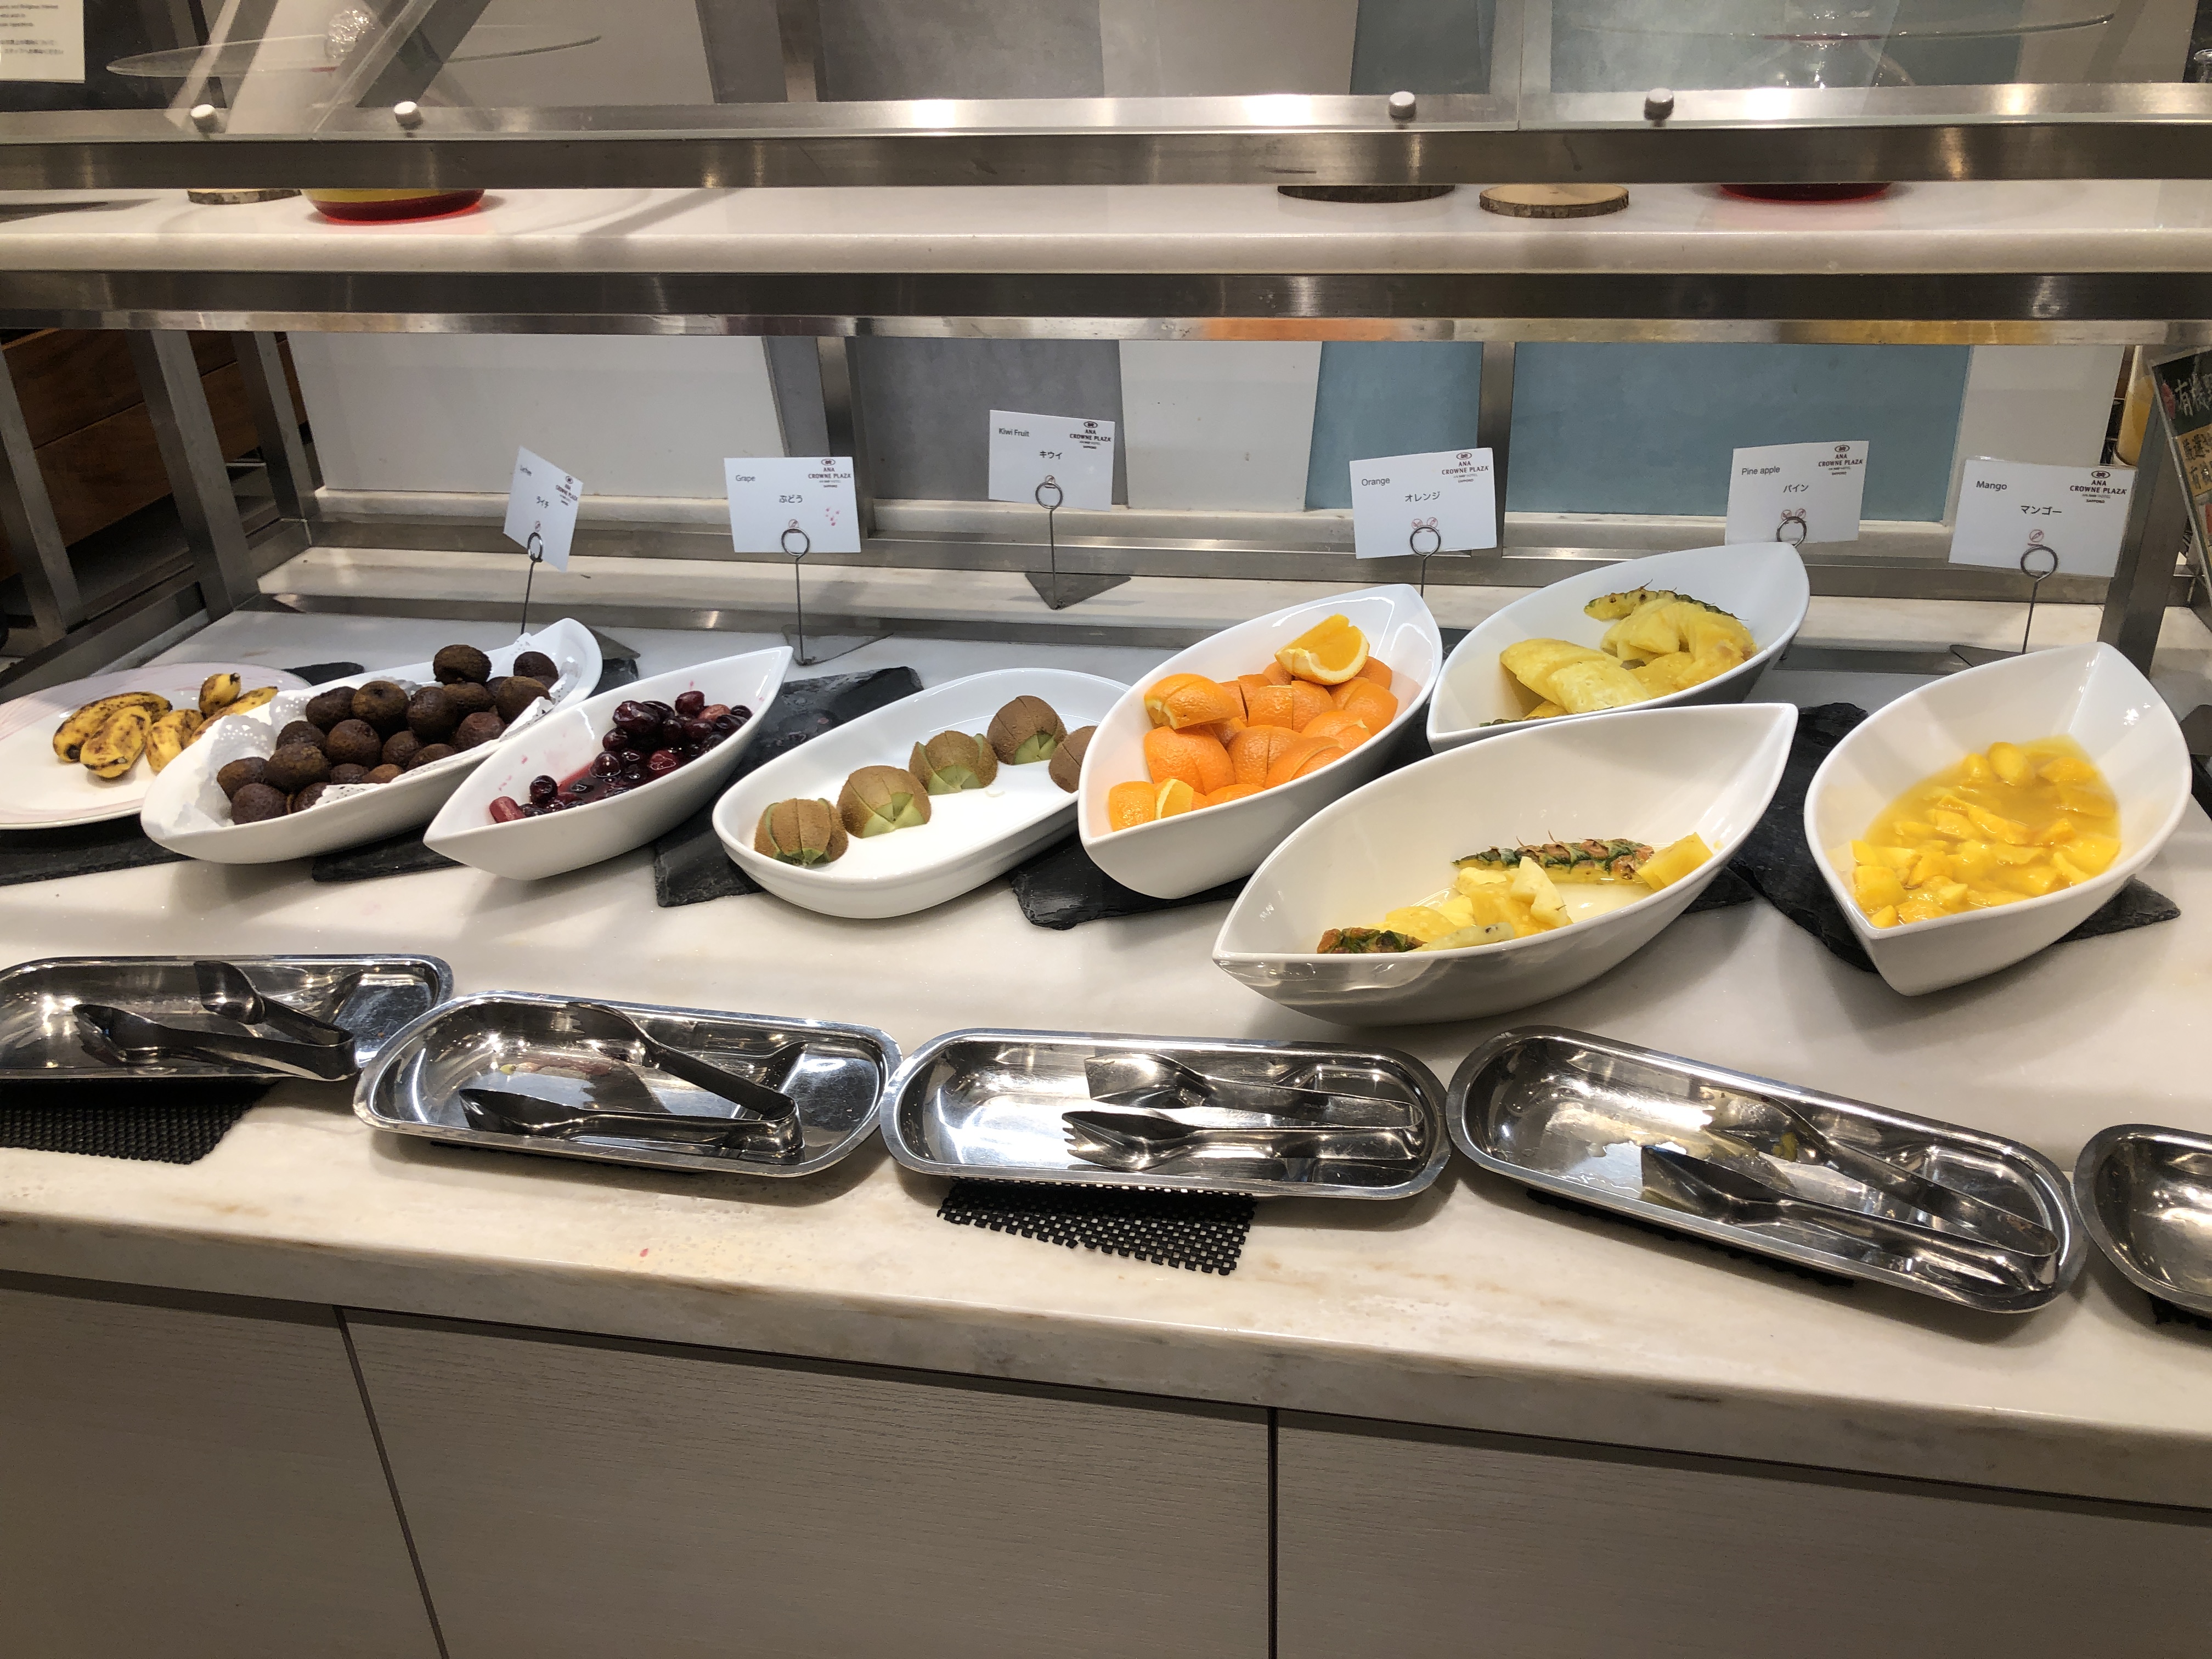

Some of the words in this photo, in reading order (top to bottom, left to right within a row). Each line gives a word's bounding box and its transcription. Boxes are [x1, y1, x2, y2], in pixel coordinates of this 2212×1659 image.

[1014, 429, 1030, 437] Fruit
[1741, 467, 1758, 476] Pine
[1759, 466, 1780, 475] apple
[736, 475, 755, 483] Grape
[1361, 477, 1390, 487] Orange
[1783, 484, 1809, 493] パイン
[1976, 481, 2007, 492] Mango
[2069, 485, 2101, 493] CROWNE
[779, 494, 803, 504] ぶどう
[1404, 491, 1441, 503] オレンジ
[2021, 505, 2062, 515] マンゴー
